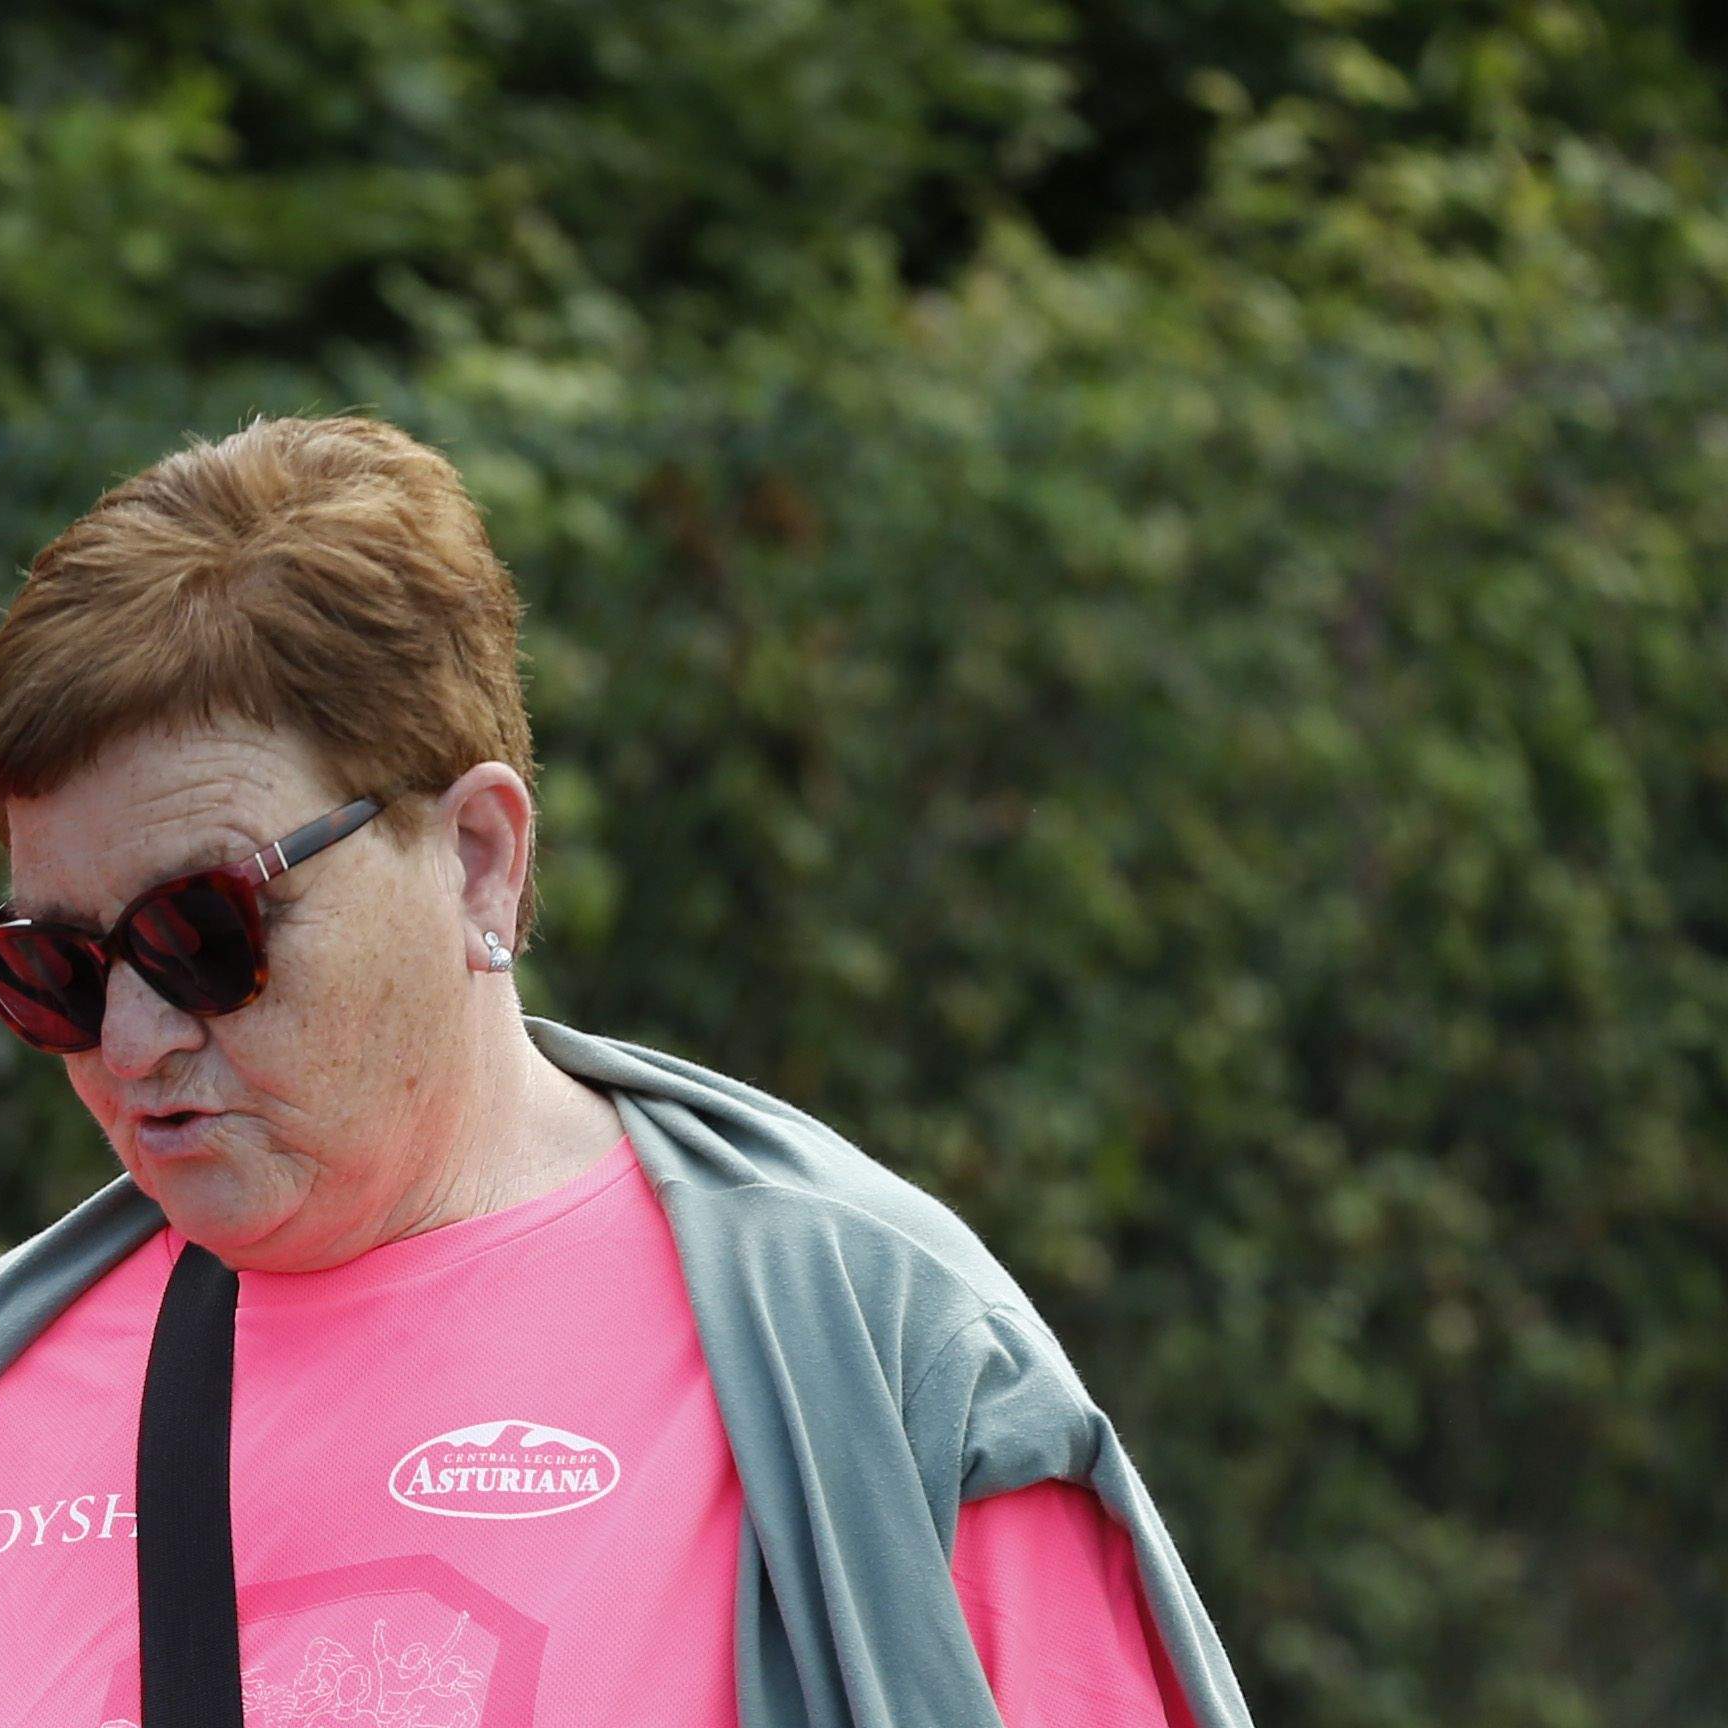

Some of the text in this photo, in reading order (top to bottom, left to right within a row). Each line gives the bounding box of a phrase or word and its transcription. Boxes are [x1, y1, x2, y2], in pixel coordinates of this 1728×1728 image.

[443, 1452, 598, 1466] CENTRAL LECHERA
[403, 1456, 601, 1496] ASTURIANA
